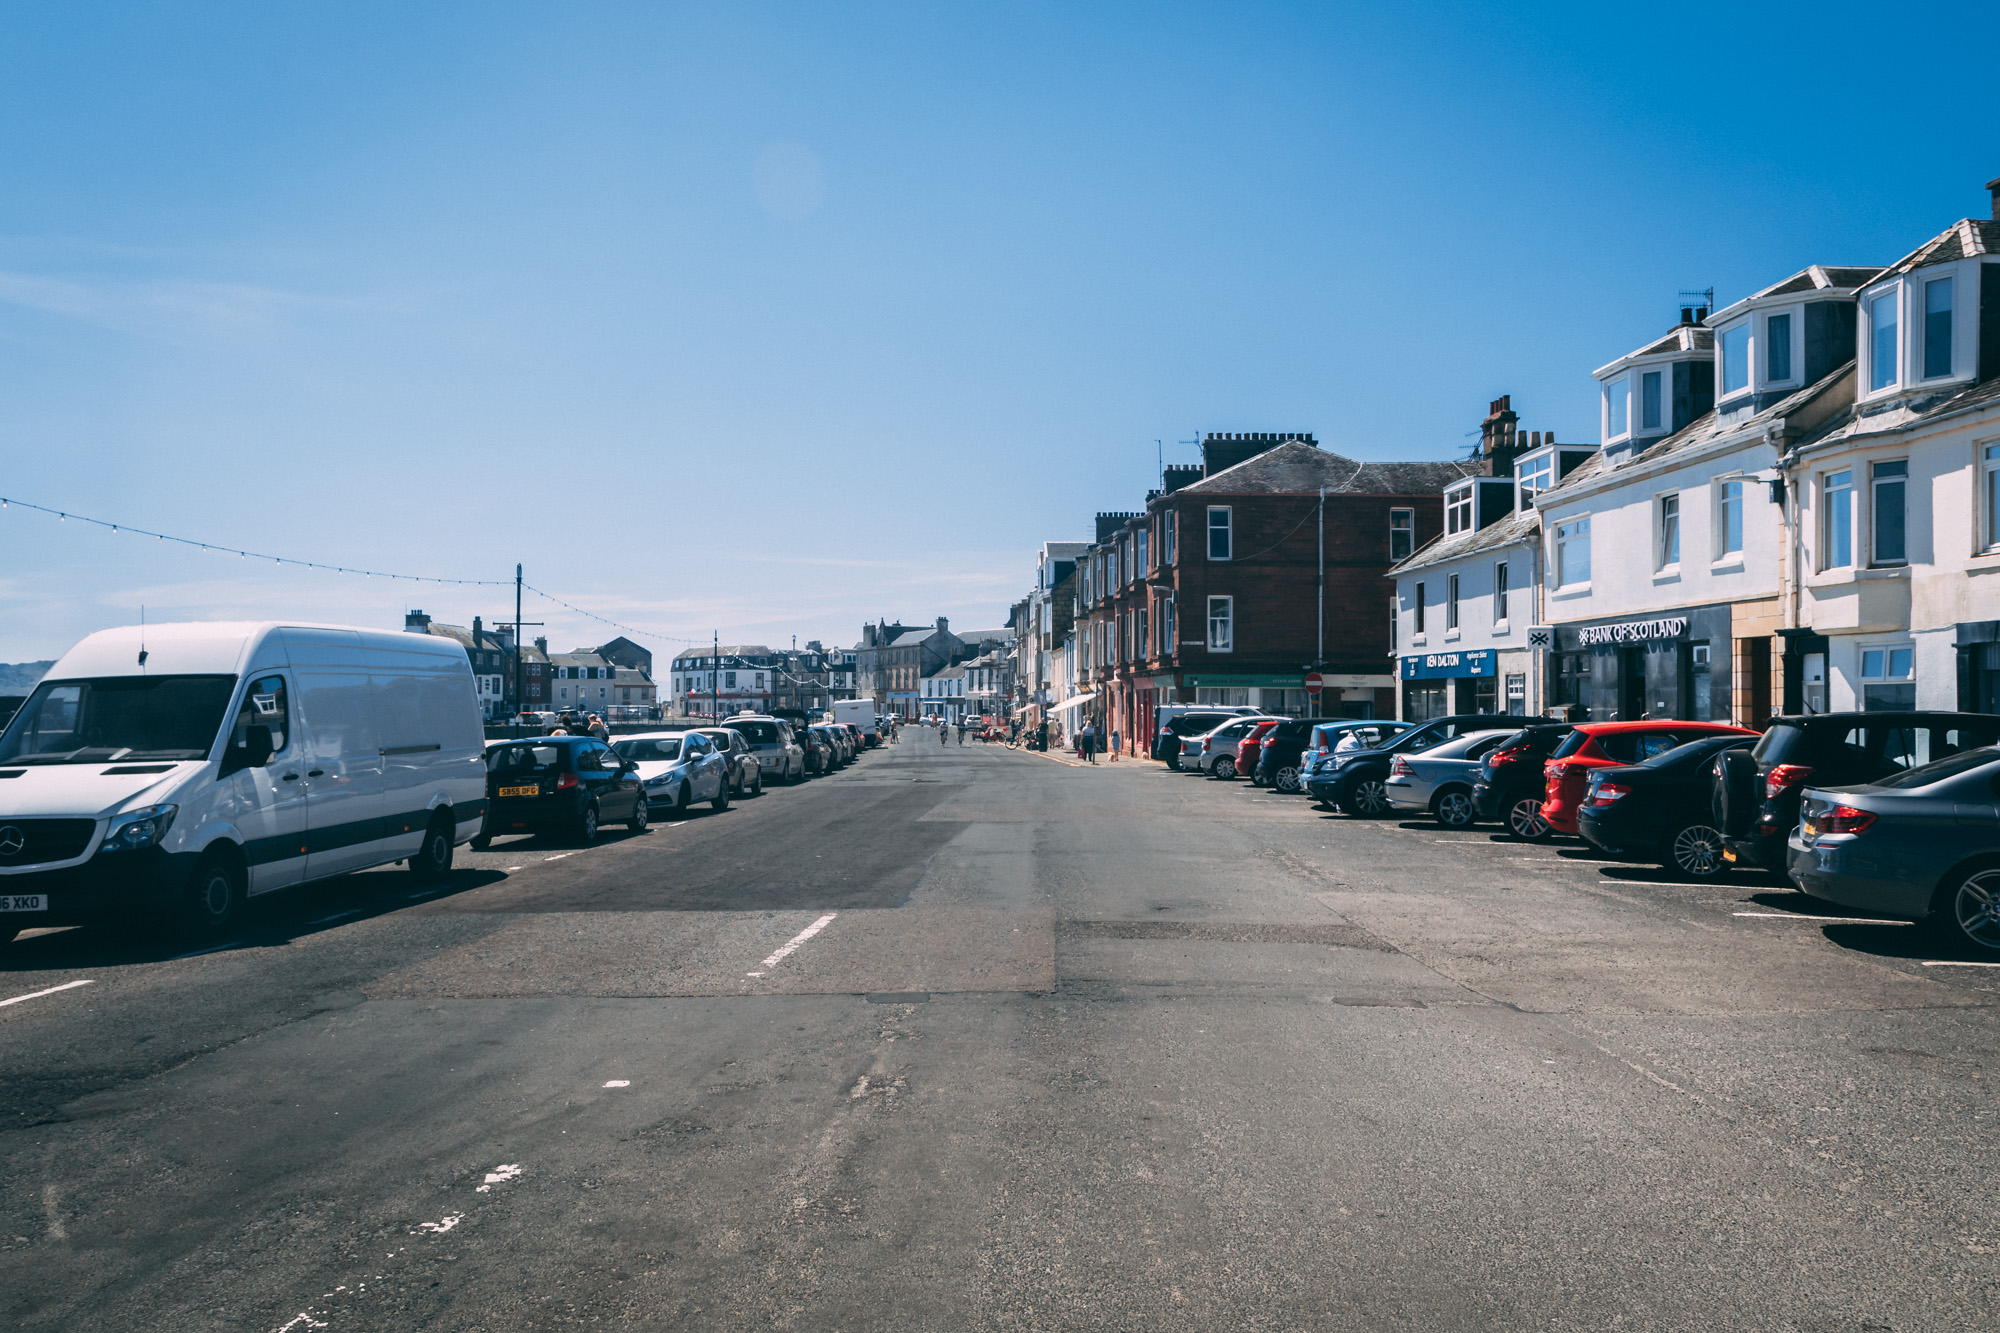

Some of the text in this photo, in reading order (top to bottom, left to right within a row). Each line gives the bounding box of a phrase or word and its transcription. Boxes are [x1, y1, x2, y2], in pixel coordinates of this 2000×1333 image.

[1589, 619, 1682, 643] BANK OF SCOTLAND
[1426, 654, 1459, 667] KEN DALTON
[13, 896, 39, 909] XKO
